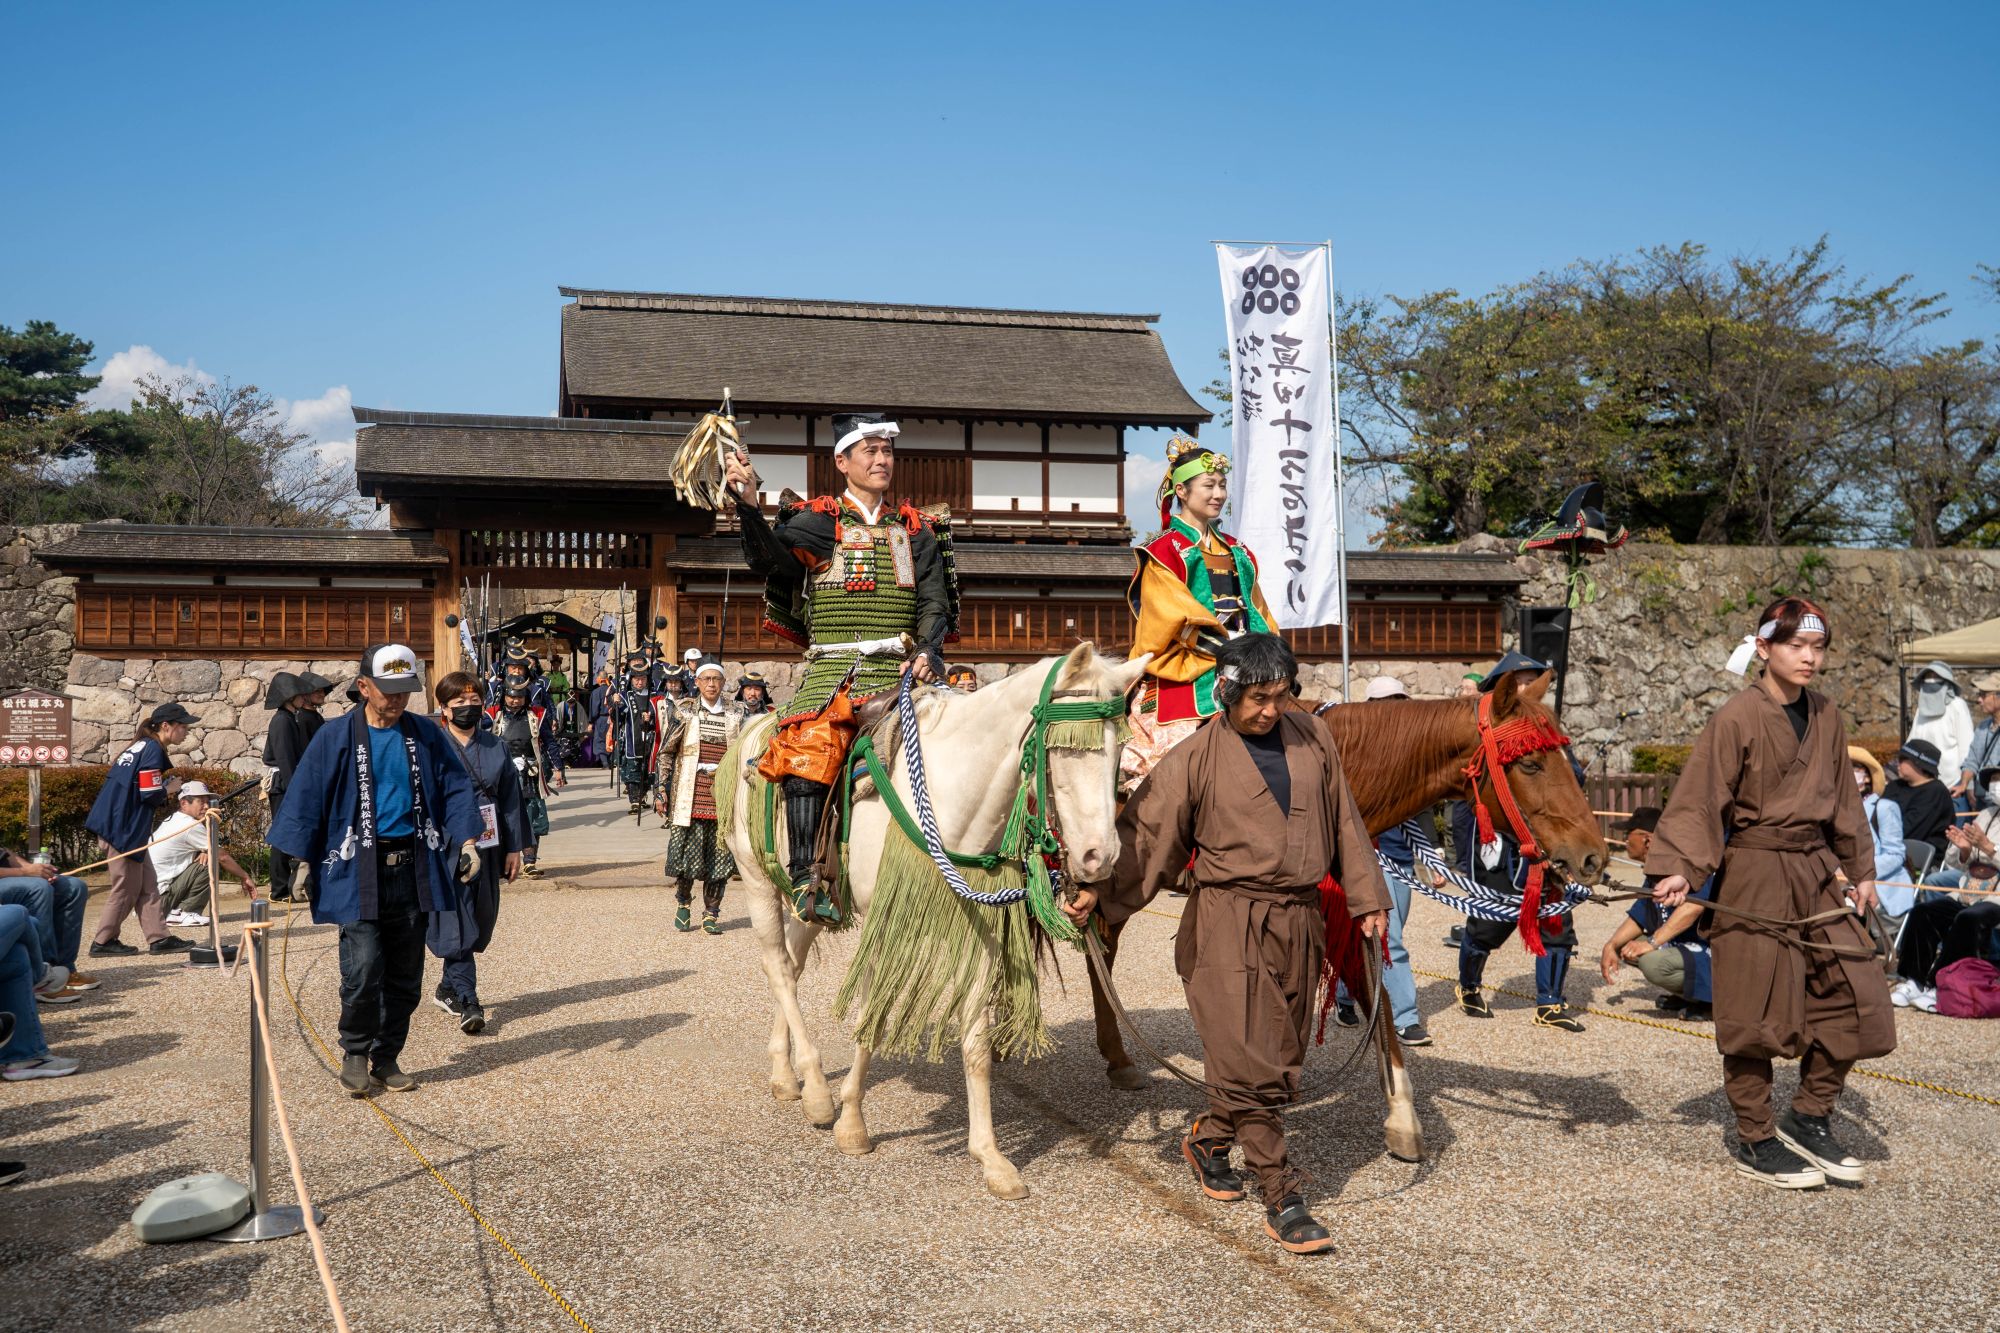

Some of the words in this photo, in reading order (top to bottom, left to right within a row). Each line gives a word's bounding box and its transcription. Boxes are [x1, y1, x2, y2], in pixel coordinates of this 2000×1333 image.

[356, 744, 373, 849] 長野商工会議所松代支部
